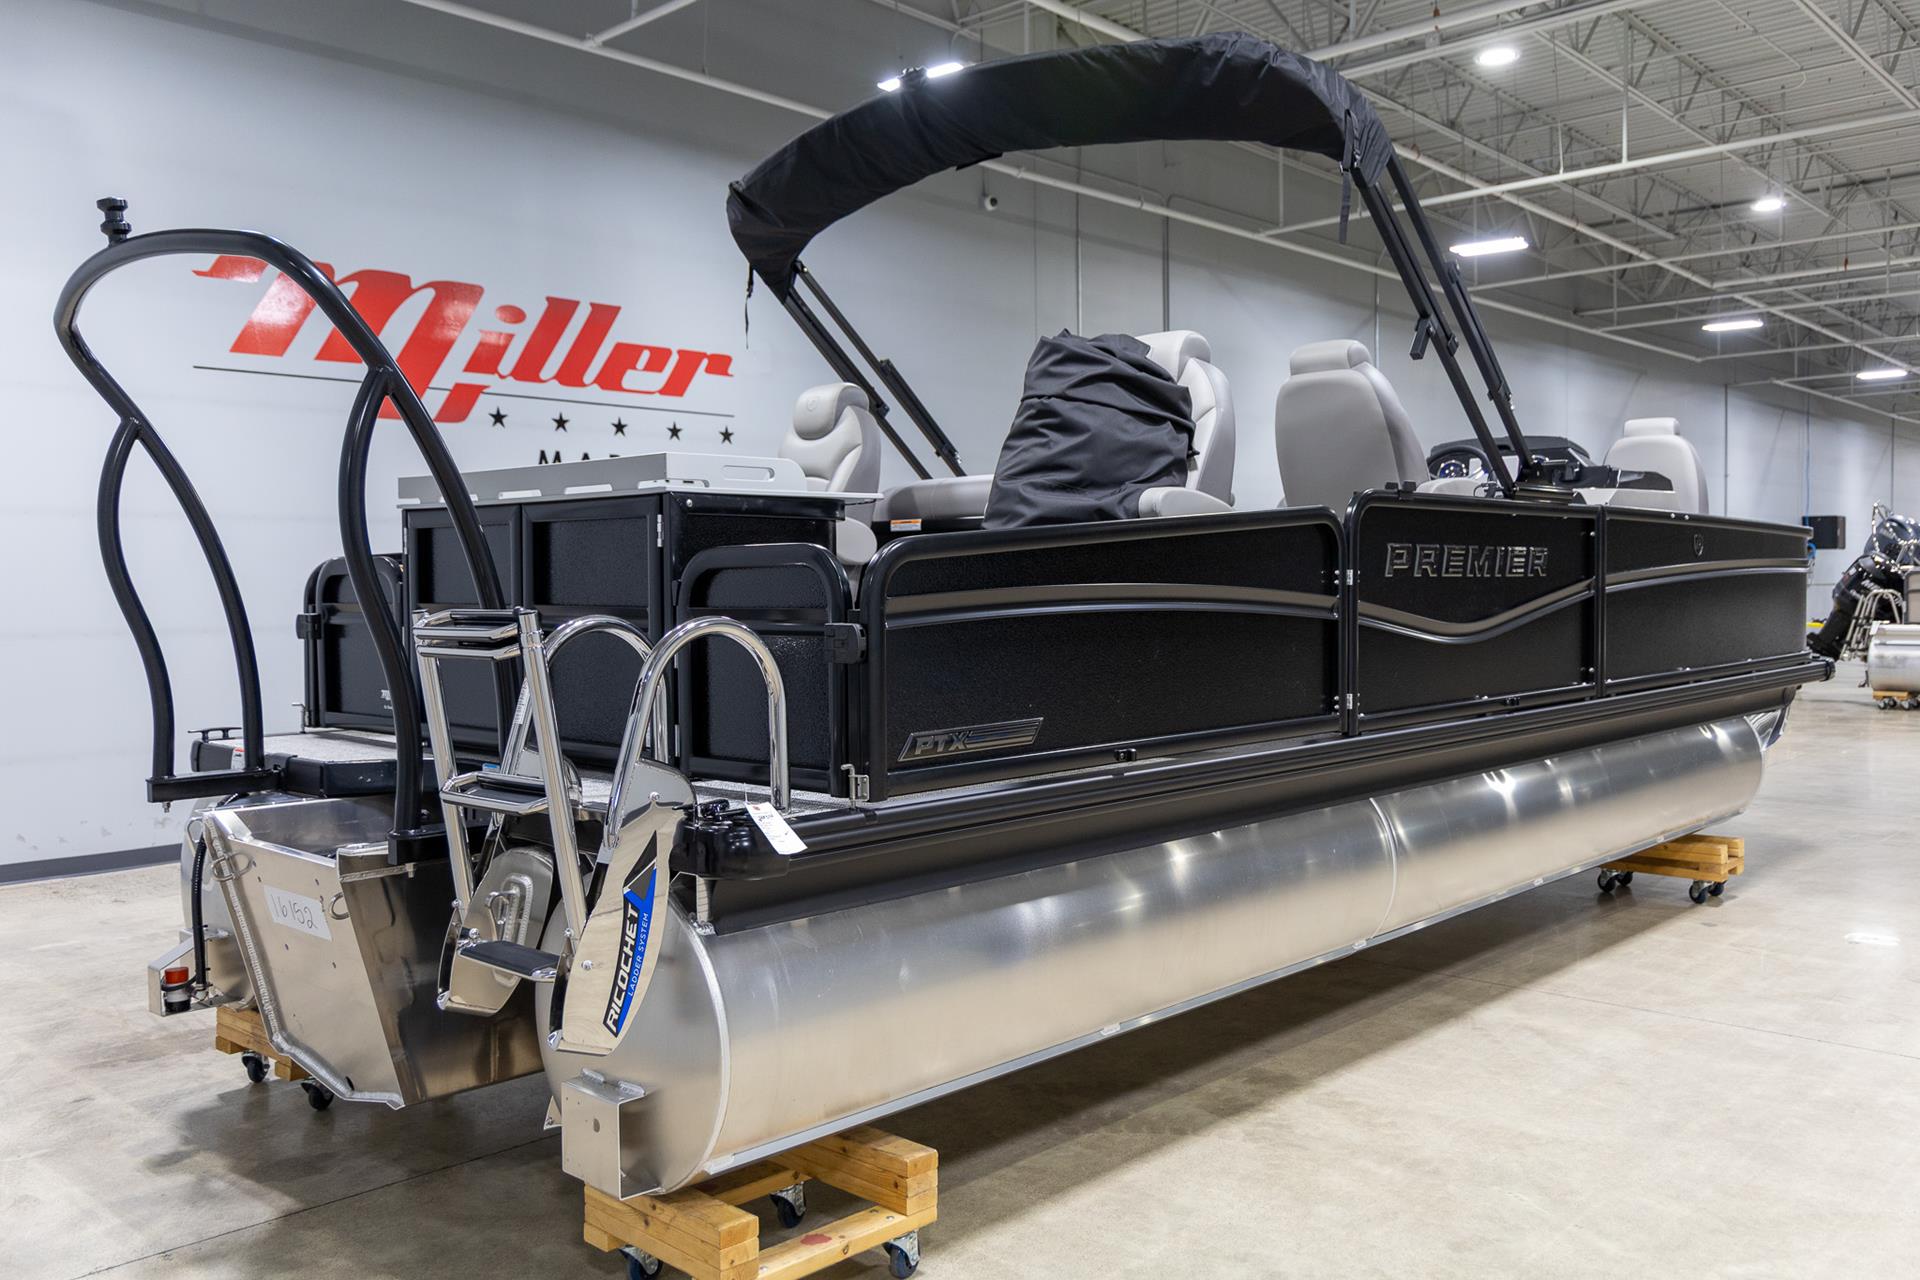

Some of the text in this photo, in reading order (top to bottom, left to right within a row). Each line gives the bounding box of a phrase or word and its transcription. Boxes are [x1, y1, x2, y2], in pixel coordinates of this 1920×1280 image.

[192, 254, 734, 423] Miller
[1384, 543, 1548, 577] PREMIER
[914, 731, 972, 755] PTX
[270, 893, 318, 930] 16152
[606, 903, 639, 1032] RICOCHET
[628, 912, 649, 996] LADDER SYSTEM
